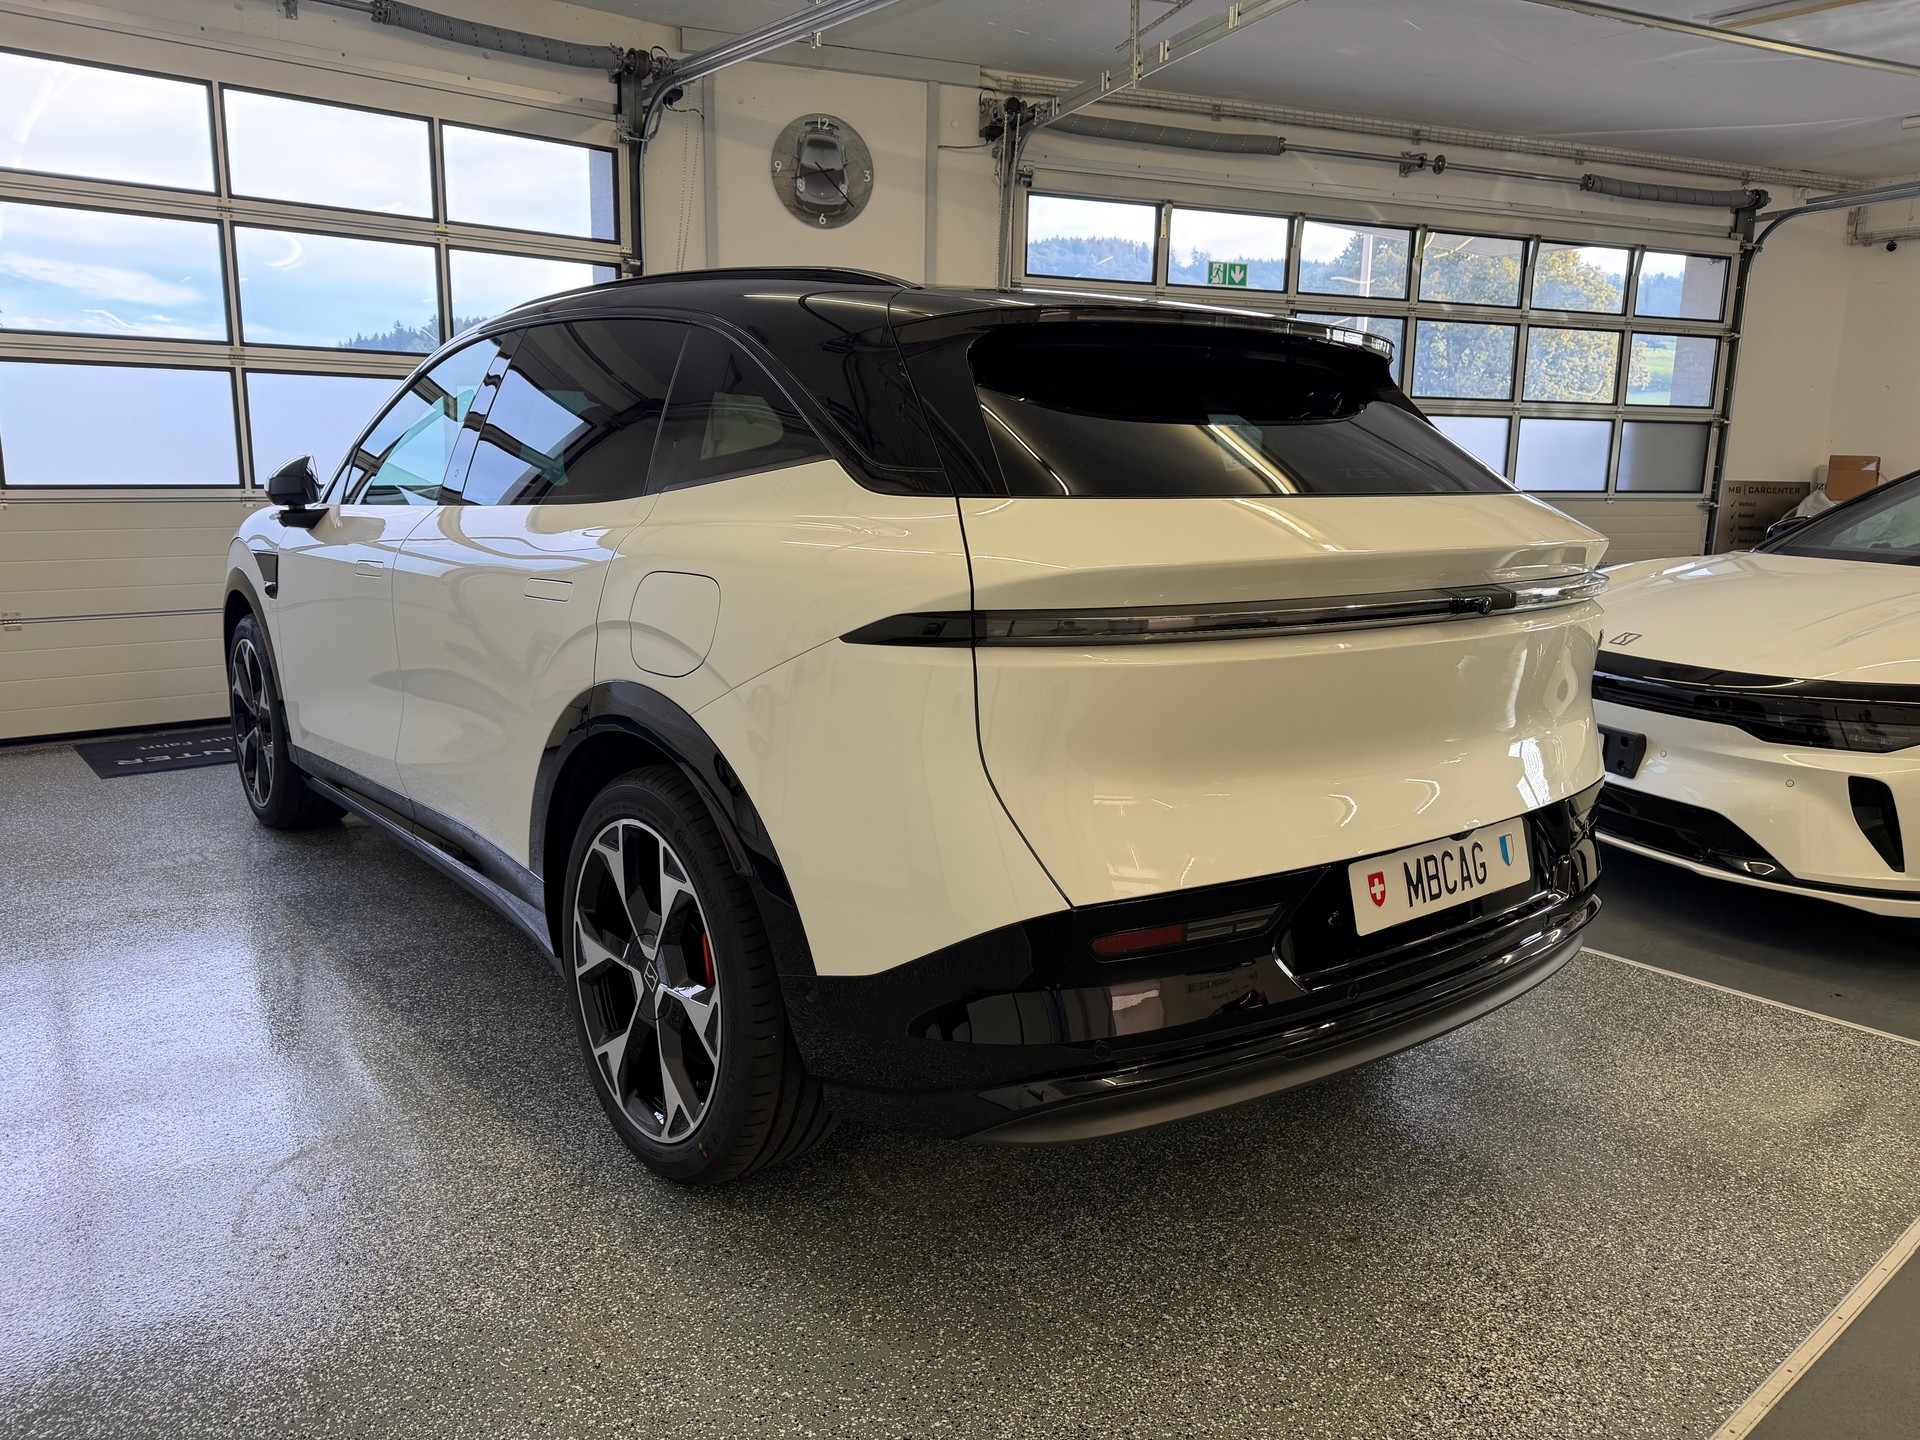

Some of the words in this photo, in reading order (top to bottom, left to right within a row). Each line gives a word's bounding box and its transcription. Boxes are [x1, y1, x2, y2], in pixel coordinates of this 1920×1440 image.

[817, 117, 830, 130] 12
[774, 160, 782, 172] 9
[863, 170, 871, 182] 3
[818, 213, 827, 225] 6
[1728, 486, 1742, 495] MB
[1748, 486, 1801, 495] CARCENTER
[1403, 840, 1487, 908] MBCAG
